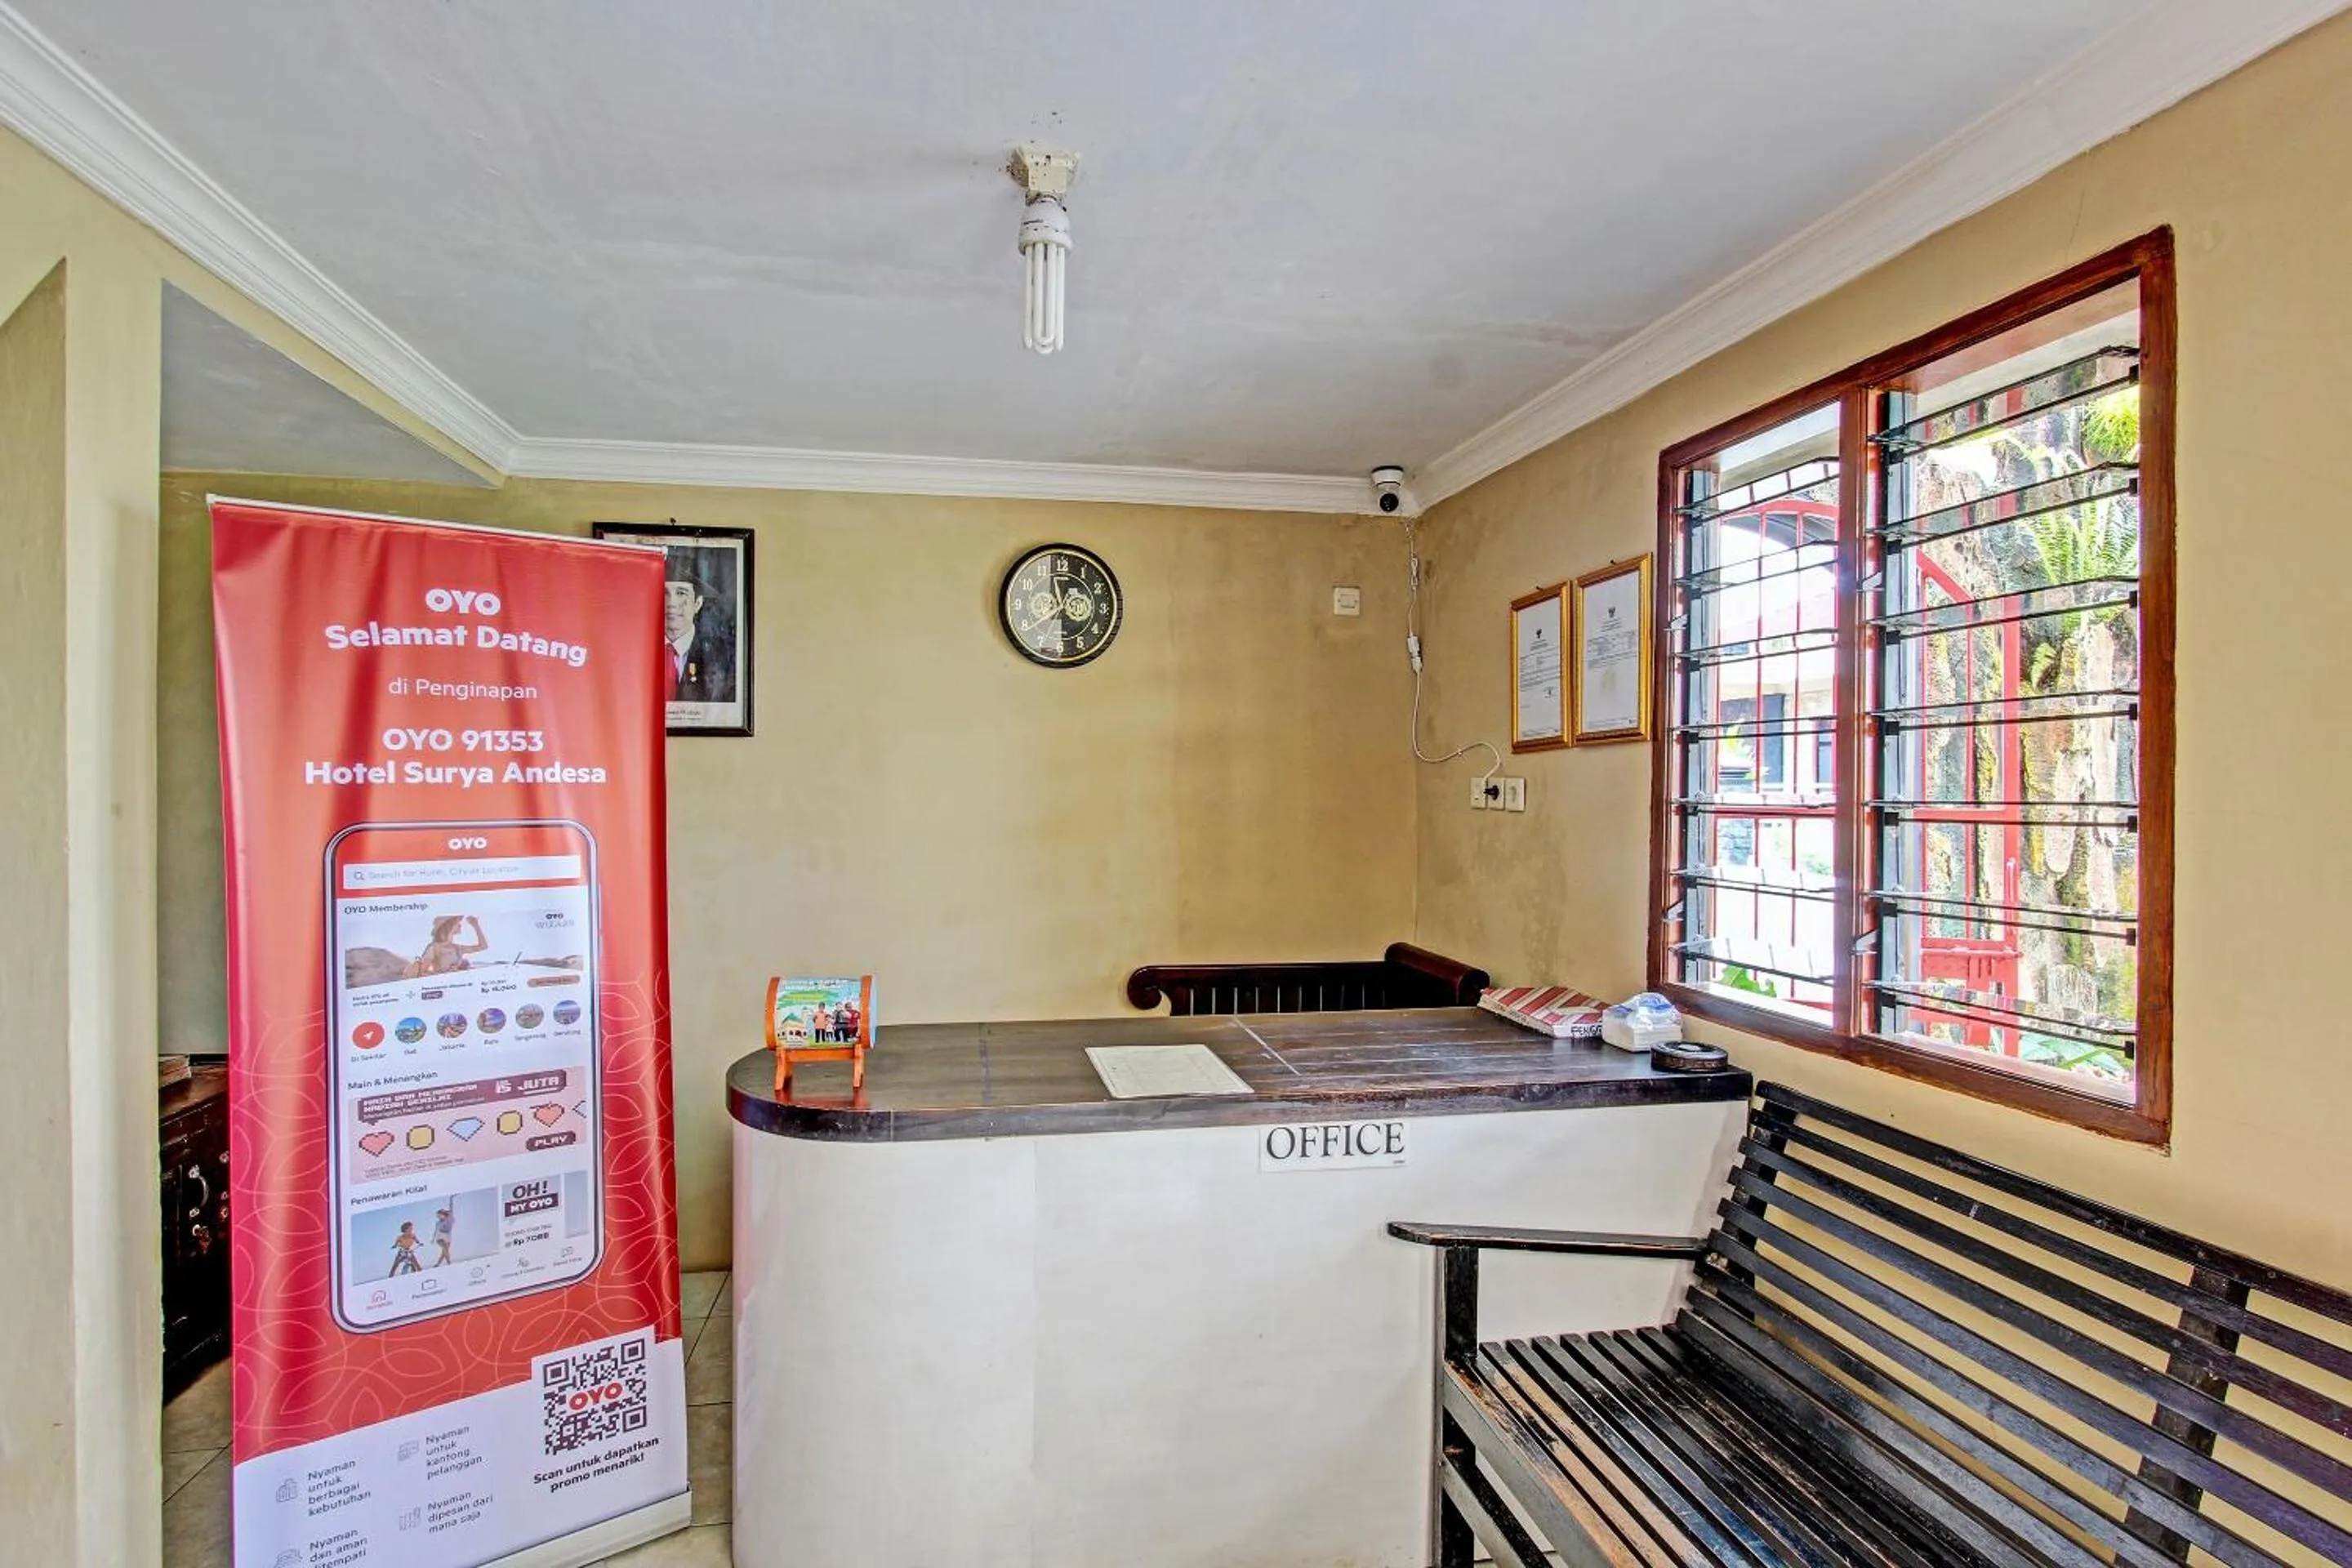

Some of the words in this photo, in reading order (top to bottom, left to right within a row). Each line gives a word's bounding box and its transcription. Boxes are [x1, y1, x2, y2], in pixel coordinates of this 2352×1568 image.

[1036, 565, 1047, 577] 11
[1056, 559, 1068, 572] 12
[1080, 567, 1086, 578] 1
[1022, 578, 1033, 590] 10
[1094, 582, 1102, 594] 2
[425, 588, 501, 616] OYO
[1013, 599, 1021, 610] 9
[1099, 603, 1107, 613] 3
[1022, 620, 1028, 630] 8
[1090, 623, 1098, 634] 4
[325, 621, 469, 649] Selamat
[477, 625, 588, 667] Datang
[1037, 635, 1044, 647] 7
[1056, 642, 1063, 653] 6
[1076, 637, 1084, 648] 5
[388, 678, 408, 695] di
[416, 679, 537, 702] Penginapan
[382, 728, 453, 751] OYO
[461, 729, 544, 752] 91353
[305, 760, 395, 785] Hotel
[403, 761, 494, 788] Surya
[502, 762, 606, 784] Andesa
[448, 836, 488, 850] OYO
[344, 906, 367, 915] OYO
[369, 902, 428, 913] Membership
[348, 1080, 372, 1090] Main
[383, 1071, 438, 1085] Menangkan
[517, 1076, 559, 1091] JUTA
[533, 1135, 568, 1147] PLAY
[1266, 1121, 1405, 1160] OFFICE
[350, 1191, 403, 1206] Penawaran
[512, 1180, 549, 1199] OH!
[510, 1202, 527, 1214] MY
[528, 1197, 553, 1209] OYO
[568, 1382, 623, 1410] OYO
[425, 1426, 470, 1445] Nyaman
[425, 1440, 457, 1456] untuk
[426, 1449, 470, 1467] kantong
[533, 1468, 564, 1485] Scan
[565, 1454, 601, 1472] untuk
[604, 1437, 660, 1461] dapatkan
[308, 1459, 356, 1481] Nyaman
[427, 1455, 482, 1480] pelanggan
[550, 1472, 590, 1493] promo
[593, 1452, 644, 1477] menarik!
[308, 1476, 342, 1493] untuk
[308, 1481, 360, 1504] berbagai
[308, 1490, 372, 1517] kebutuhan
[427, 1491, 471, 1511] Nyaman
[427, 1503, 470, 1522] dipesan
[472, 1494, 493, 1508] dari
[429, 1519, 457, 1534] mana
[460, 1509, 481, 1524] saja
[310, 1529, 359, 1551] Nyaman
[310, 1550, 332, 1563] dan
[336, 1537, 368, 1554] aman
